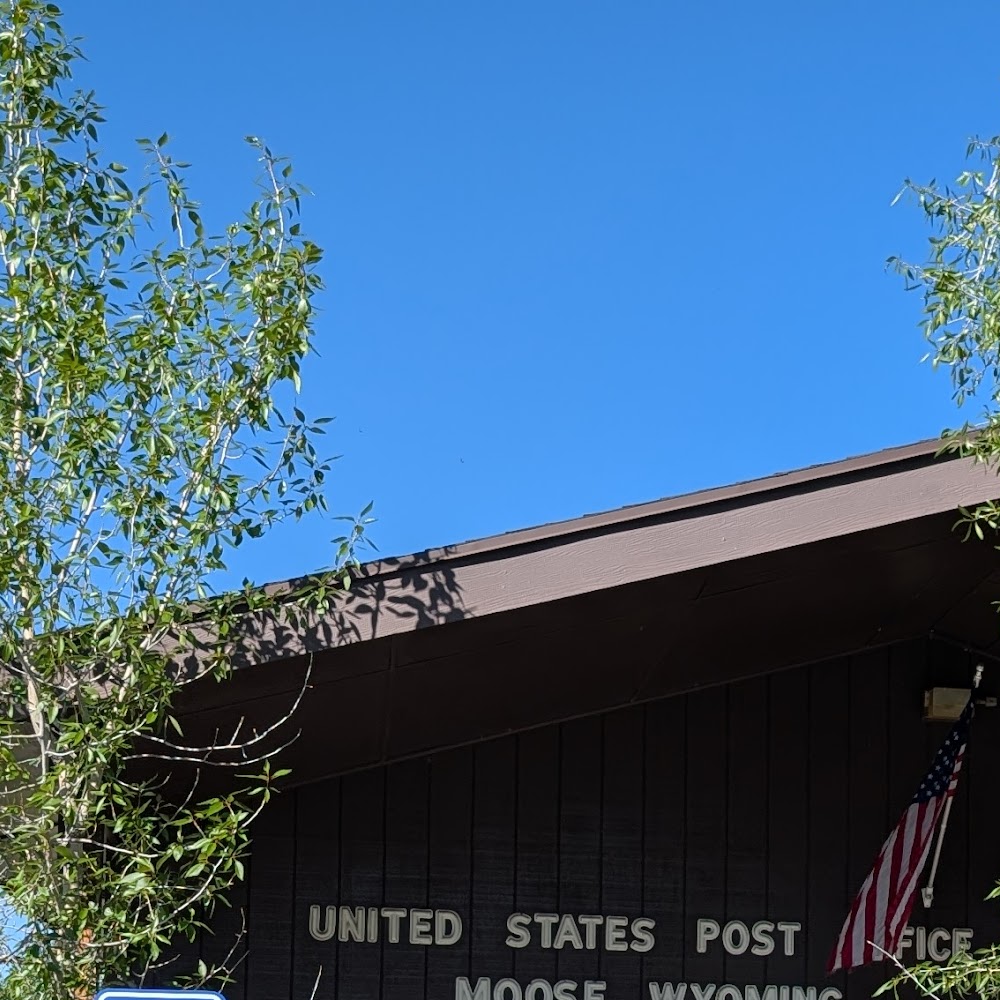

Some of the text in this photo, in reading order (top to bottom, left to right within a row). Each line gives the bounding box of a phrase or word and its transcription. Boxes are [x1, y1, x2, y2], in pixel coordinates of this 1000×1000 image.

[308, 905, 974, 961] UNITED STATES POST FICE
